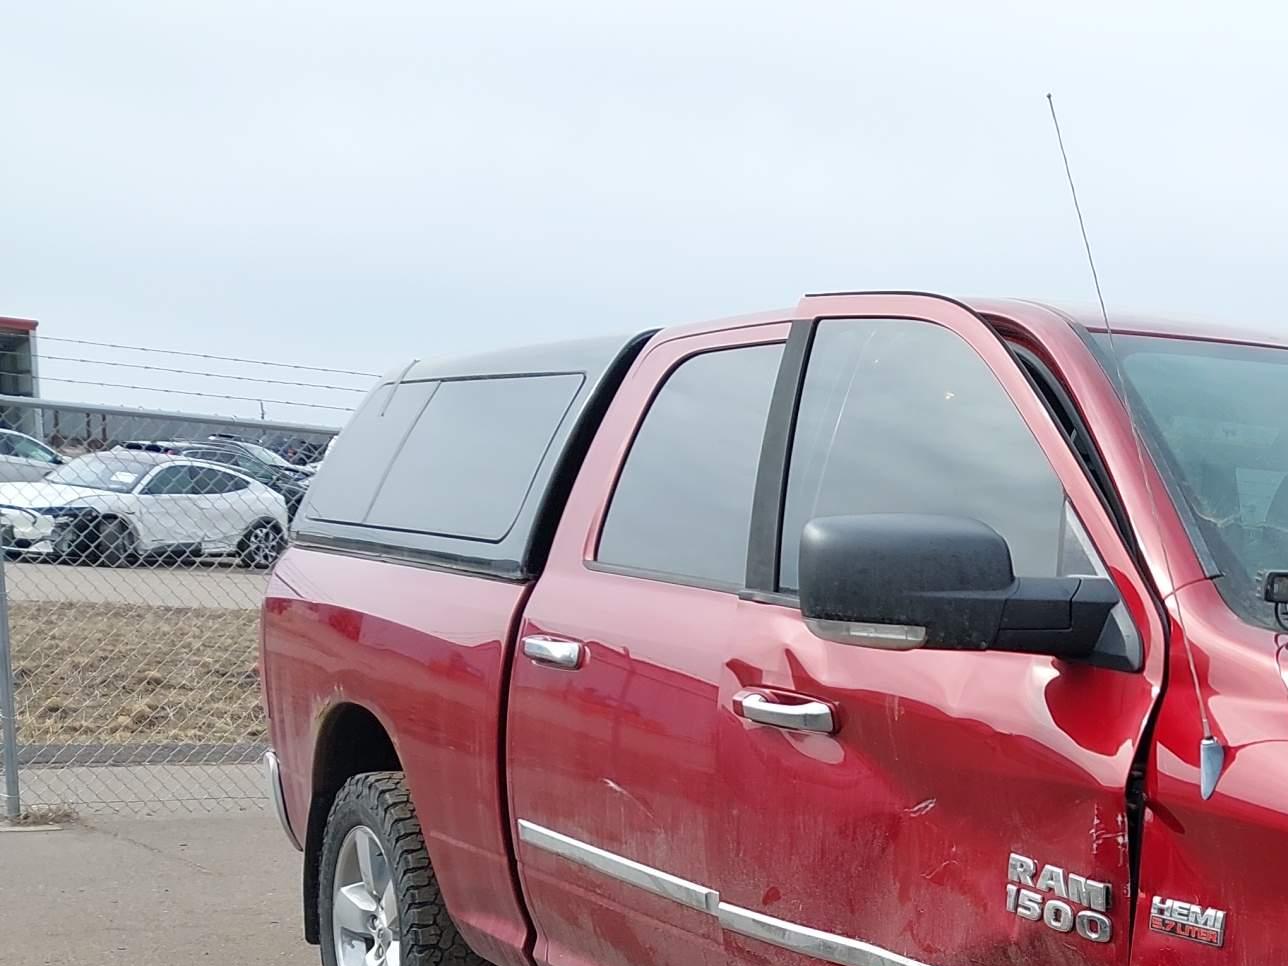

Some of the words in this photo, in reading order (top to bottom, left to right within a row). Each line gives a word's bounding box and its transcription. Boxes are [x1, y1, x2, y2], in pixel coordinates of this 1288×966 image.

[1007, 853, 1112, 912] RAM
[1006, 883, 1112, 943] 1500
[1151, 895, 1226, 929] HEMI
[1151, 916, 1175, 931] 5.7
[1176, 921, 1217, 943] LITER
